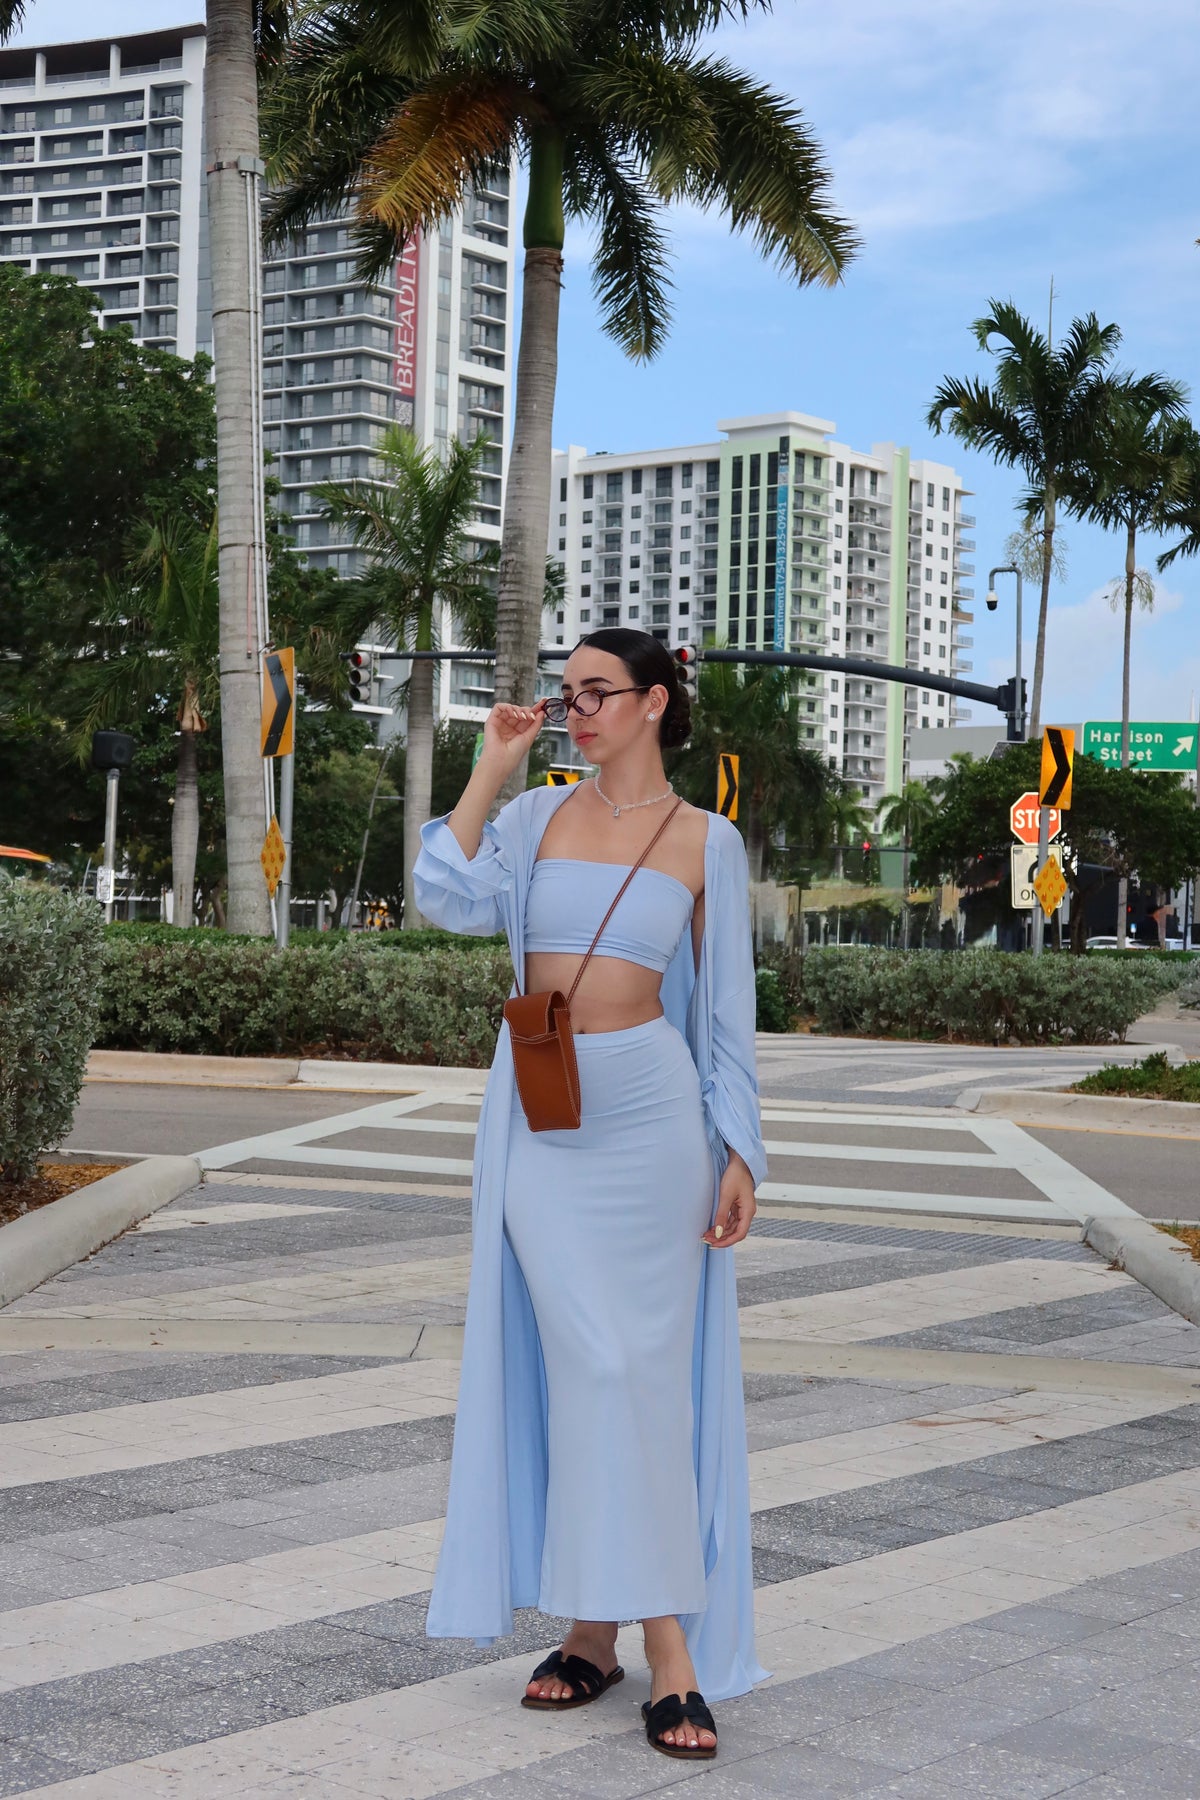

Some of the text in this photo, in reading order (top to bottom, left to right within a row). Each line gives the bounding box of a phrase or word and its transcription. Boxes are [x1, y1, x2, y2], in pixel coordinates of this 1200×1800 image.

[396, 232, 417, 389] BREADLIV
[774, 502, 788, 649] Apartments (754) 325-0941
[1090, 729, 1163, 744] Harison
